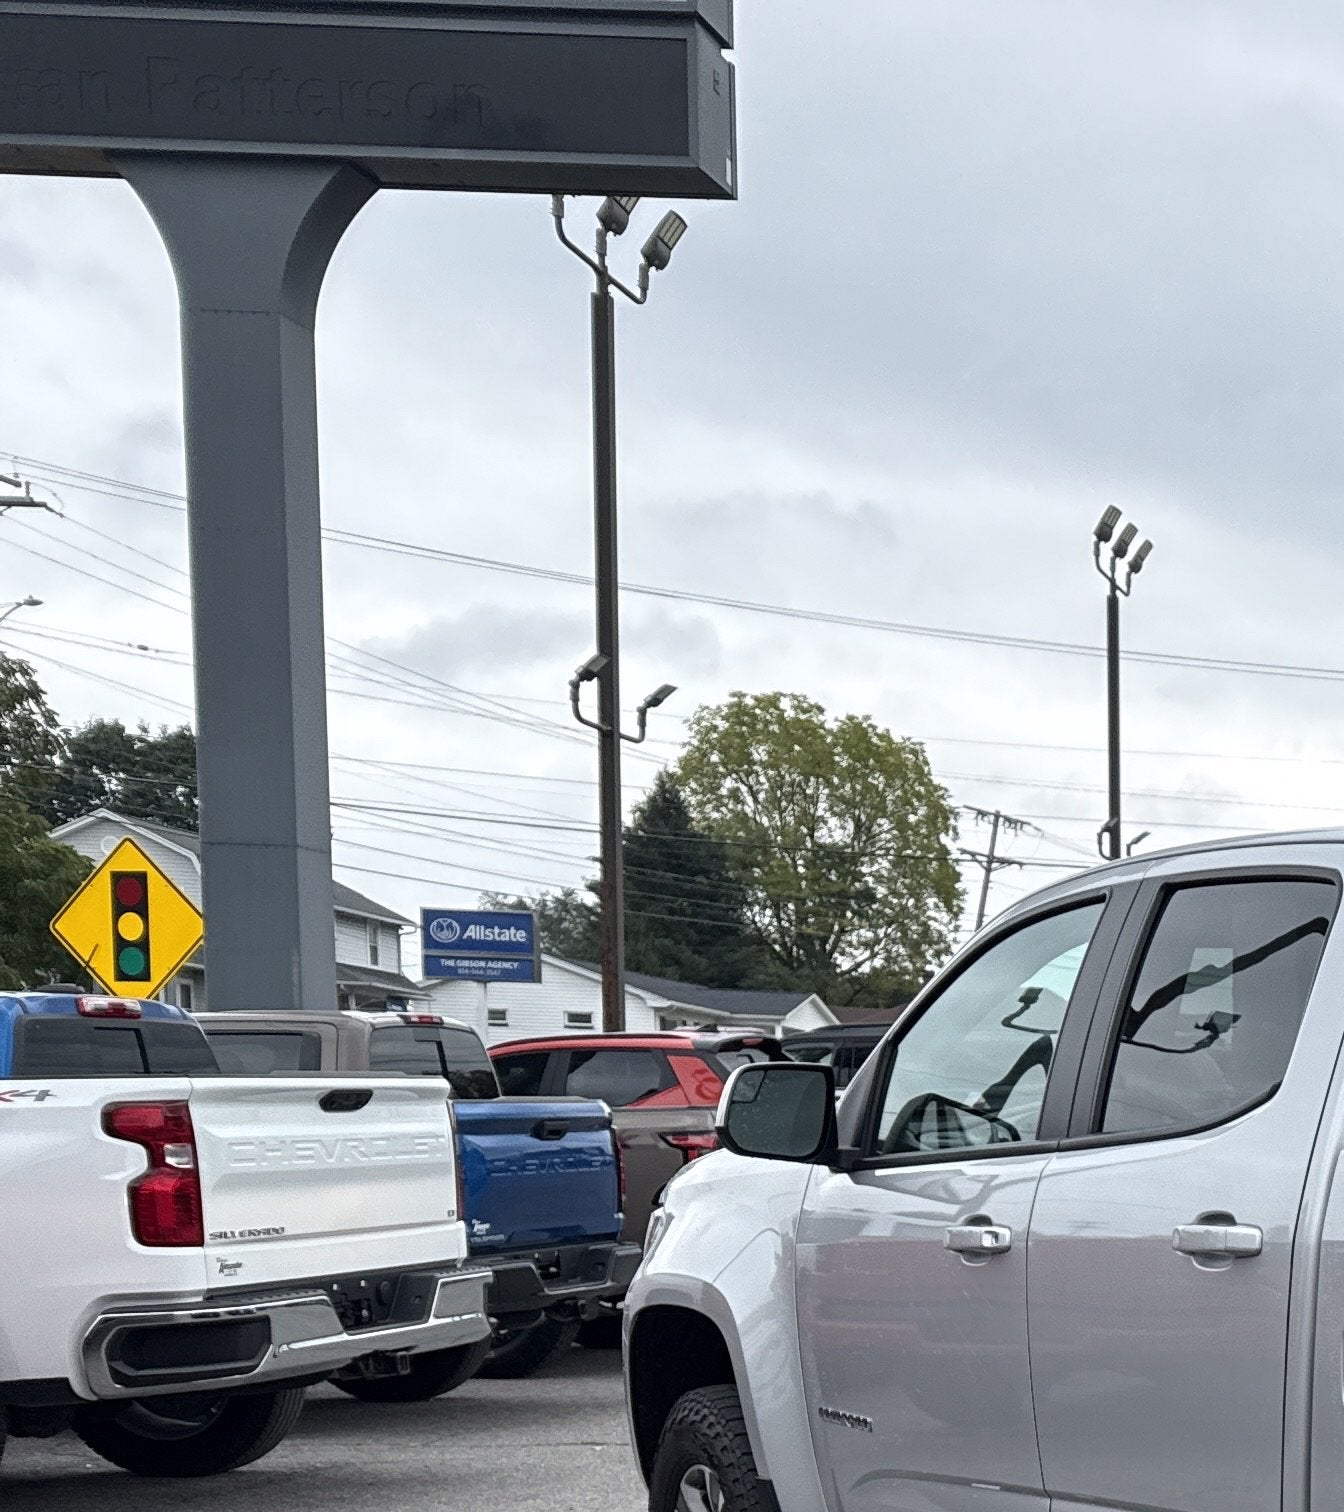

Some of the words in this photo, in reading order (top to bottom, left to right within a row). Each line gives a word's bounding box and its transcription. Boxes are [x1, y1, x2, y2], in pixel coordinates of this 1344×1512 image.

[145, 56, 489, 127] Patterson
[462, 924, 527, 942] Allstate
[487, 960, 519, 970] AGENCY
[228, 1135, 446, 1167] CHEVROLET
